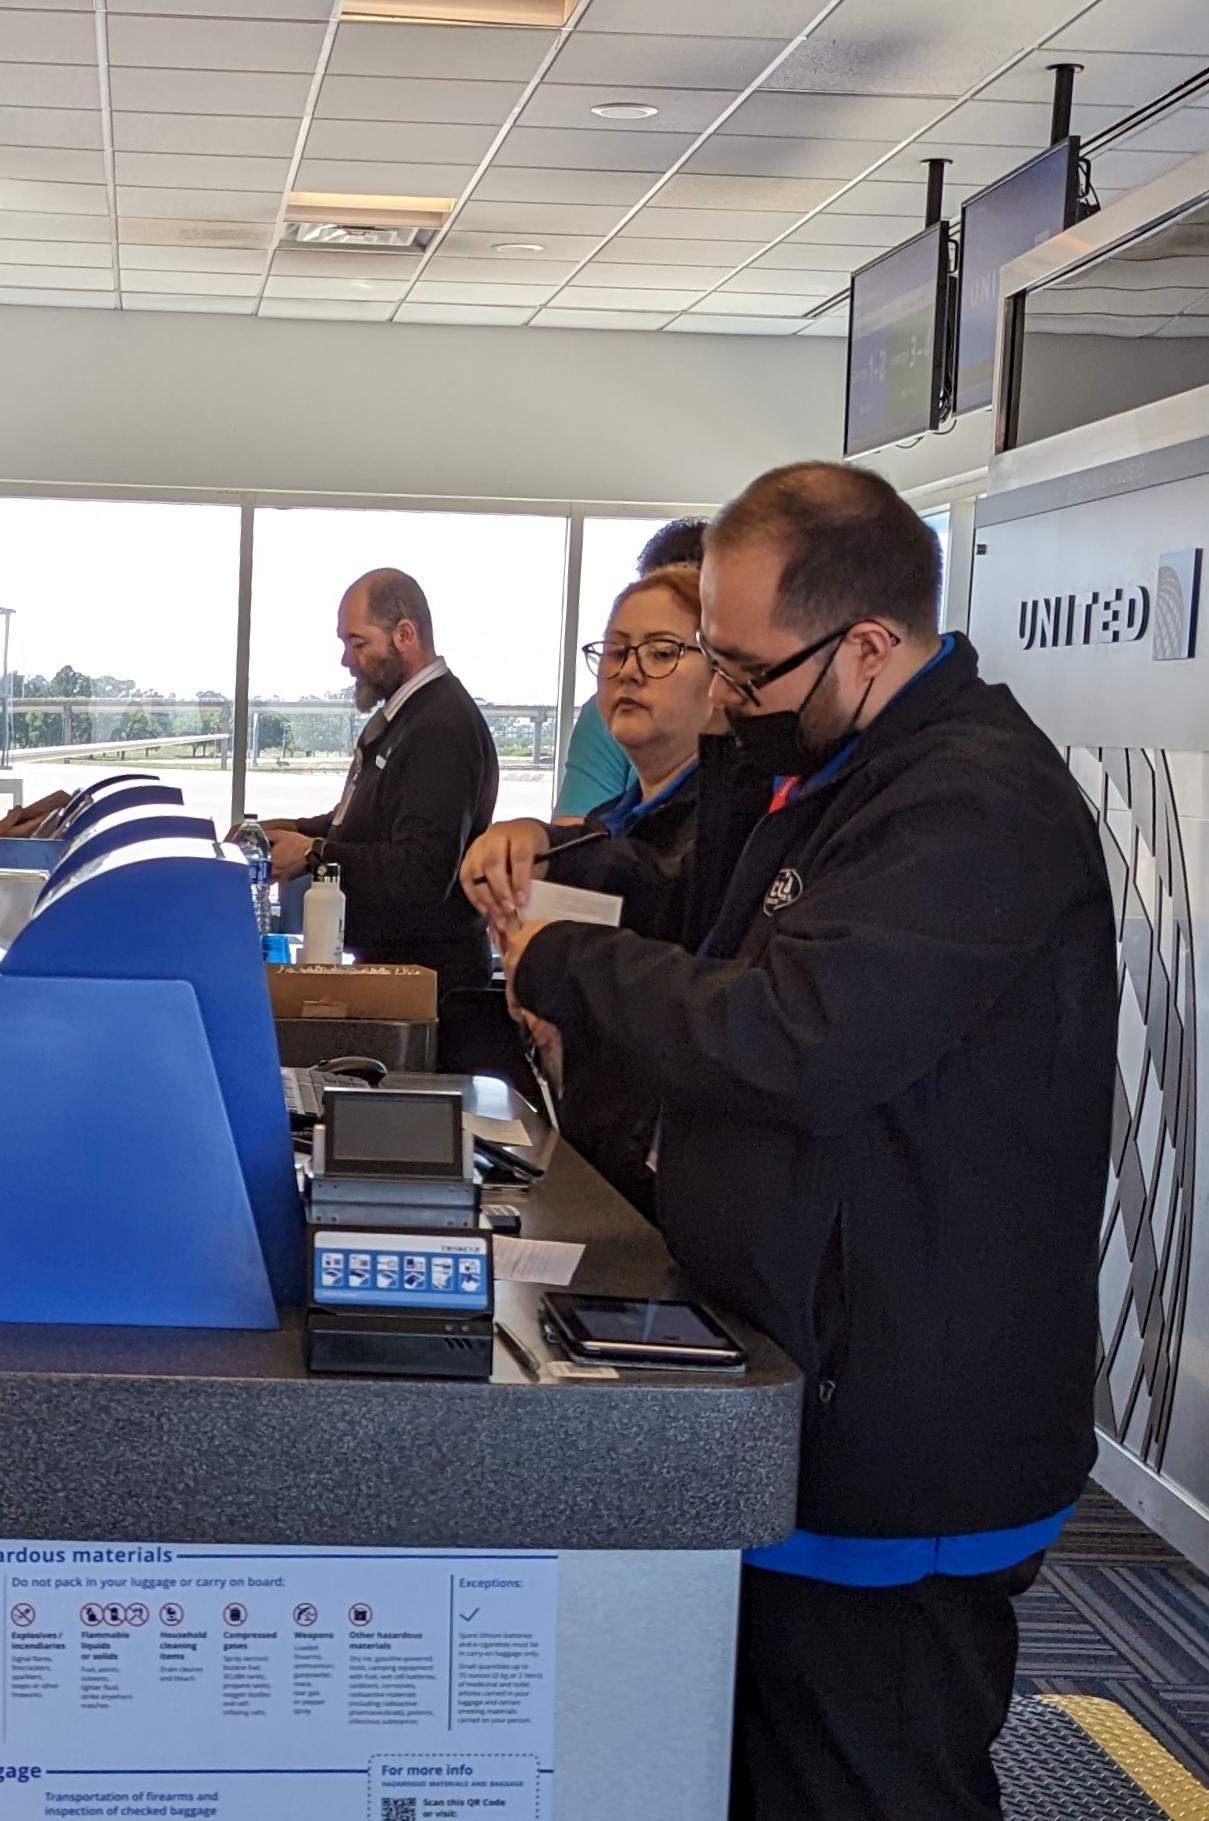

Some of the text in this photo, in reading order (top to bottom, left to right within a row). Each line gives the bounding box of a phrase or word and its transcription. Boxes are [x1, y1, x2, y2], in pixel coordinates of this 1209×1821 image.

[970, 268, 997, 308] UNI
[1018, 584, 1150, 651] UNITED
[72, 1547, 173, 1564] materials
[12, 1577, 286, 1590] Do not pack in your luggage or carry on board:
[460, 1578, 523, 1590] Exceptions:
[12, 1632, 57, 1640] Explosives
[224, 1632, 278, 1640] Compressed
[294, 1632, 334, 1641] Weapons
[160, 1643, 197, 1651] cleaning
[349, 1642, 392, 1650] materials
[382, 1764, 474, 1775] For more info
[45, 1792, 218, 1803] Transportation of firearms and
[447, 1798, 465, 1806] this
[467, 1799, 480, 1807] QR
[45, 1806, 217, 1817] inspection of checked baggage
